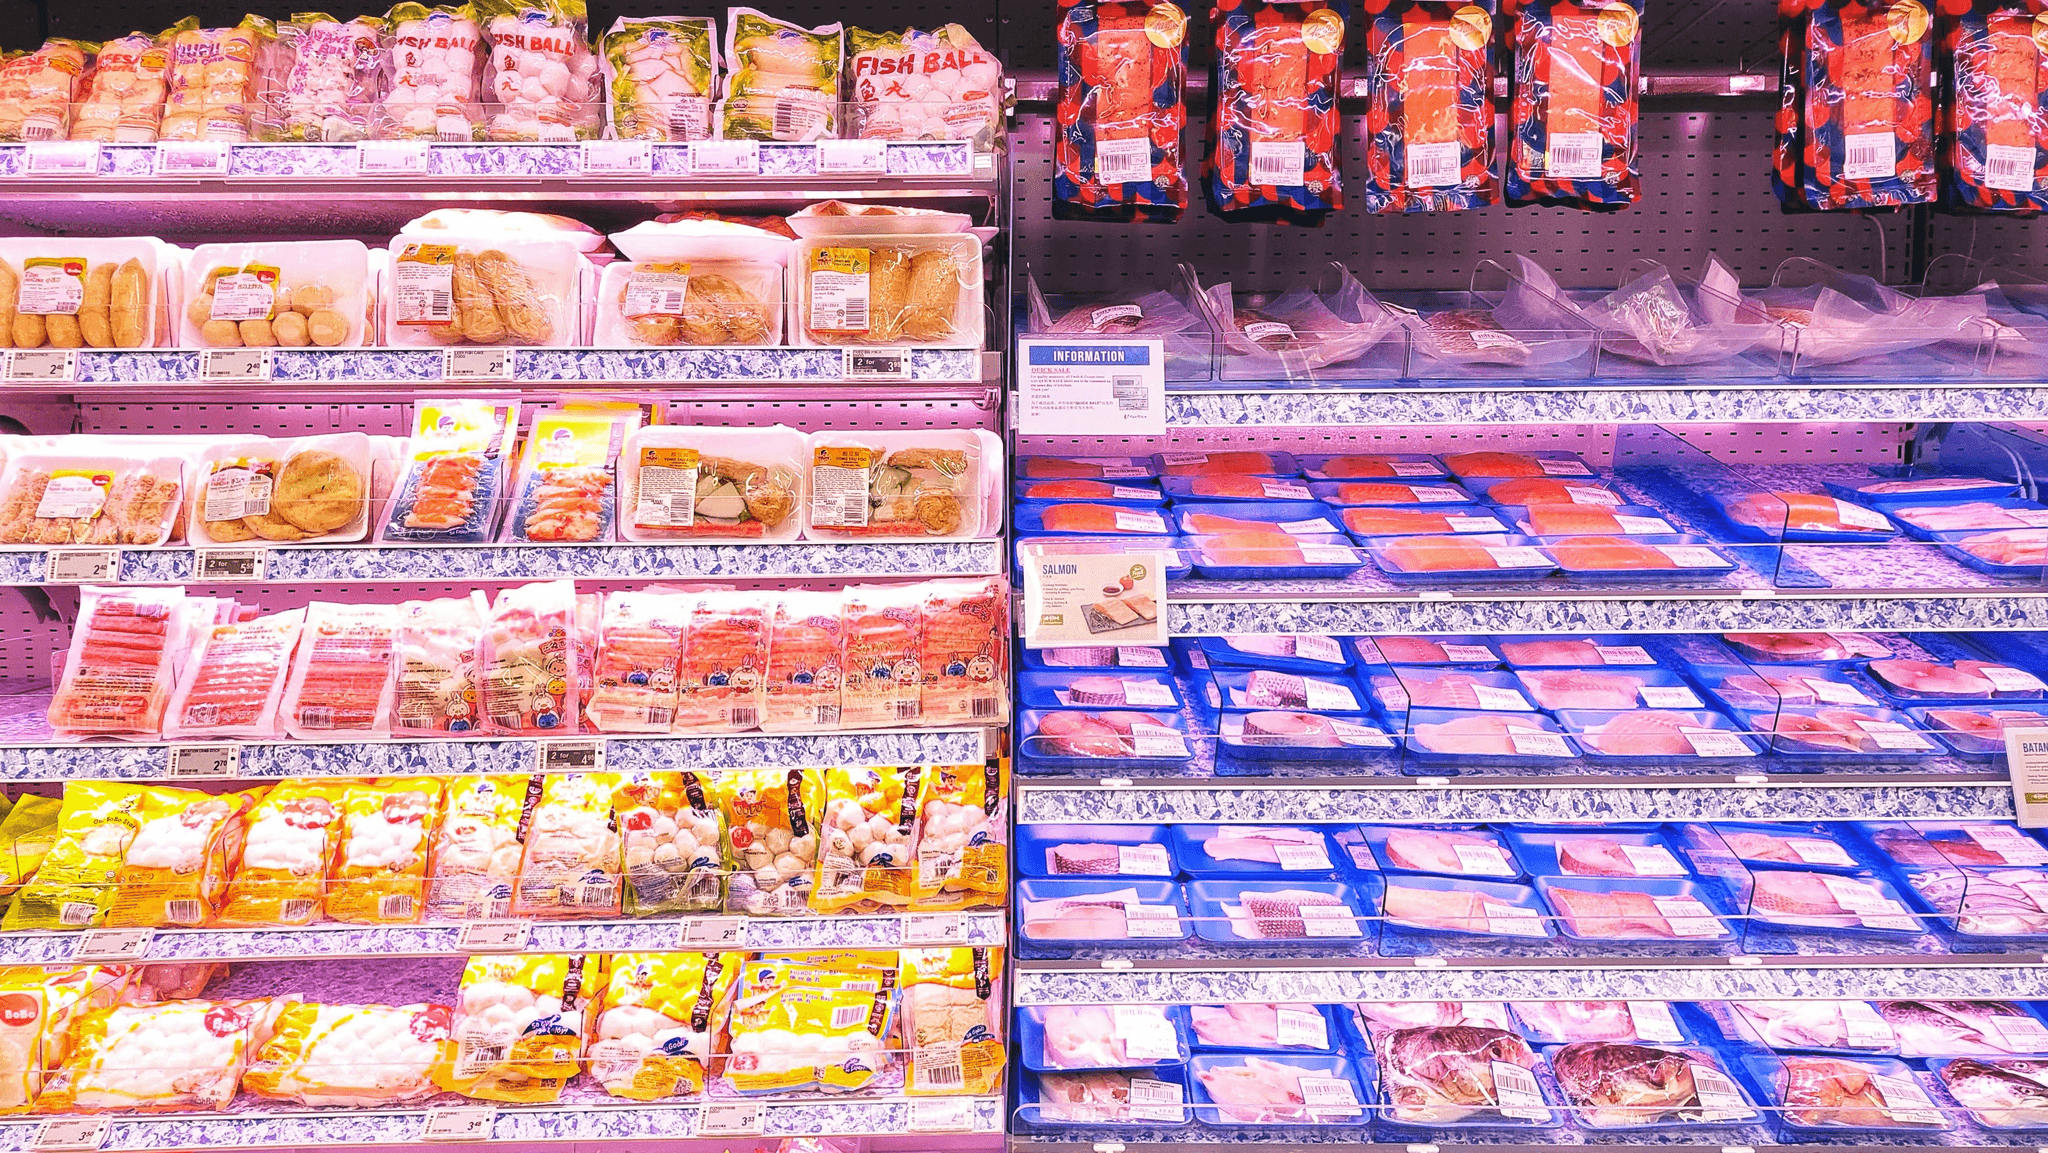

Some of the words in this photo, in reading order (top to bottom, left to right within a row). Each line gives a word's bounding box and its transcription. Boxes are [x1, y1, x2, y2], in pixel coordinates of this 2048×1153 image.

[435, 37, 475, 52] BALL
[530, 34, 574, 56] BALL
[856, 53, 916, 77] FISH
[923, 50, 987, 74] BALL
[866, 358, 876, 366] for
[1053, 351, 1125, 362] INFORMATION
[209, 560, 216, 568] 2
[1042, 564, 1077, 575] SALMON
[550, 752, 557, 760] 2
[722, 930, 737, 939] 222
[4, 1009, 36, 1020] BoBo
